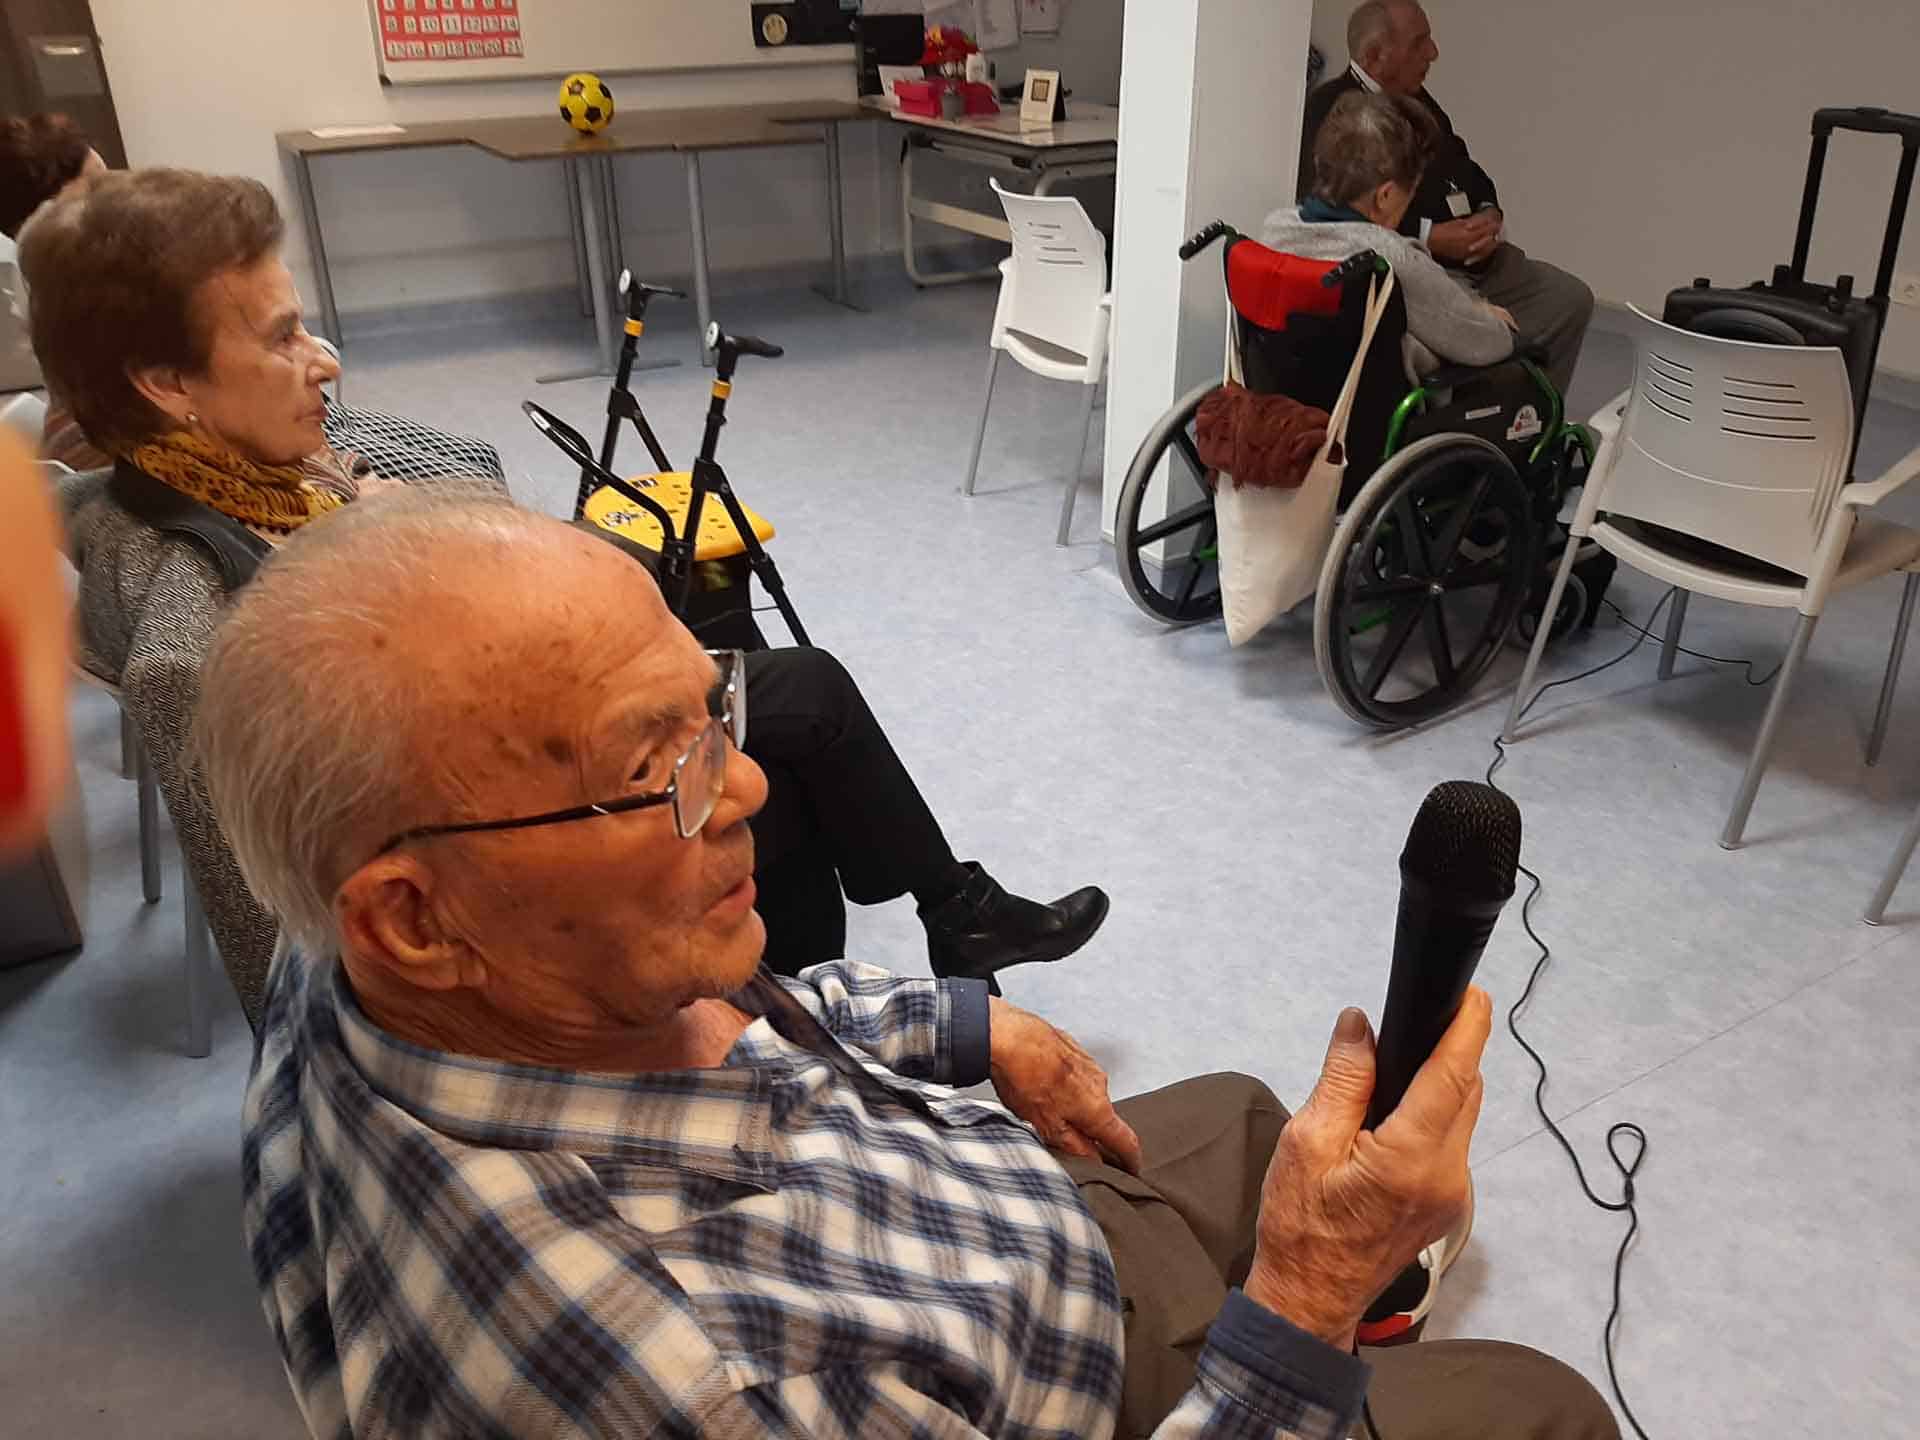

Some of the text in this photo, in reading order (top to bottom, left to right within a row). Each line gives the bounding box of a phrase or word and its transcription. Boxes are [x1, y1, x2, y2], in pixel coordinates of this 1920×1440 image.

[424, 18, 437, 31] 10
[446, 18, 458, 31] 11
[467, 18, 480, 31] 12
[504, 17, 517, 31] 14
